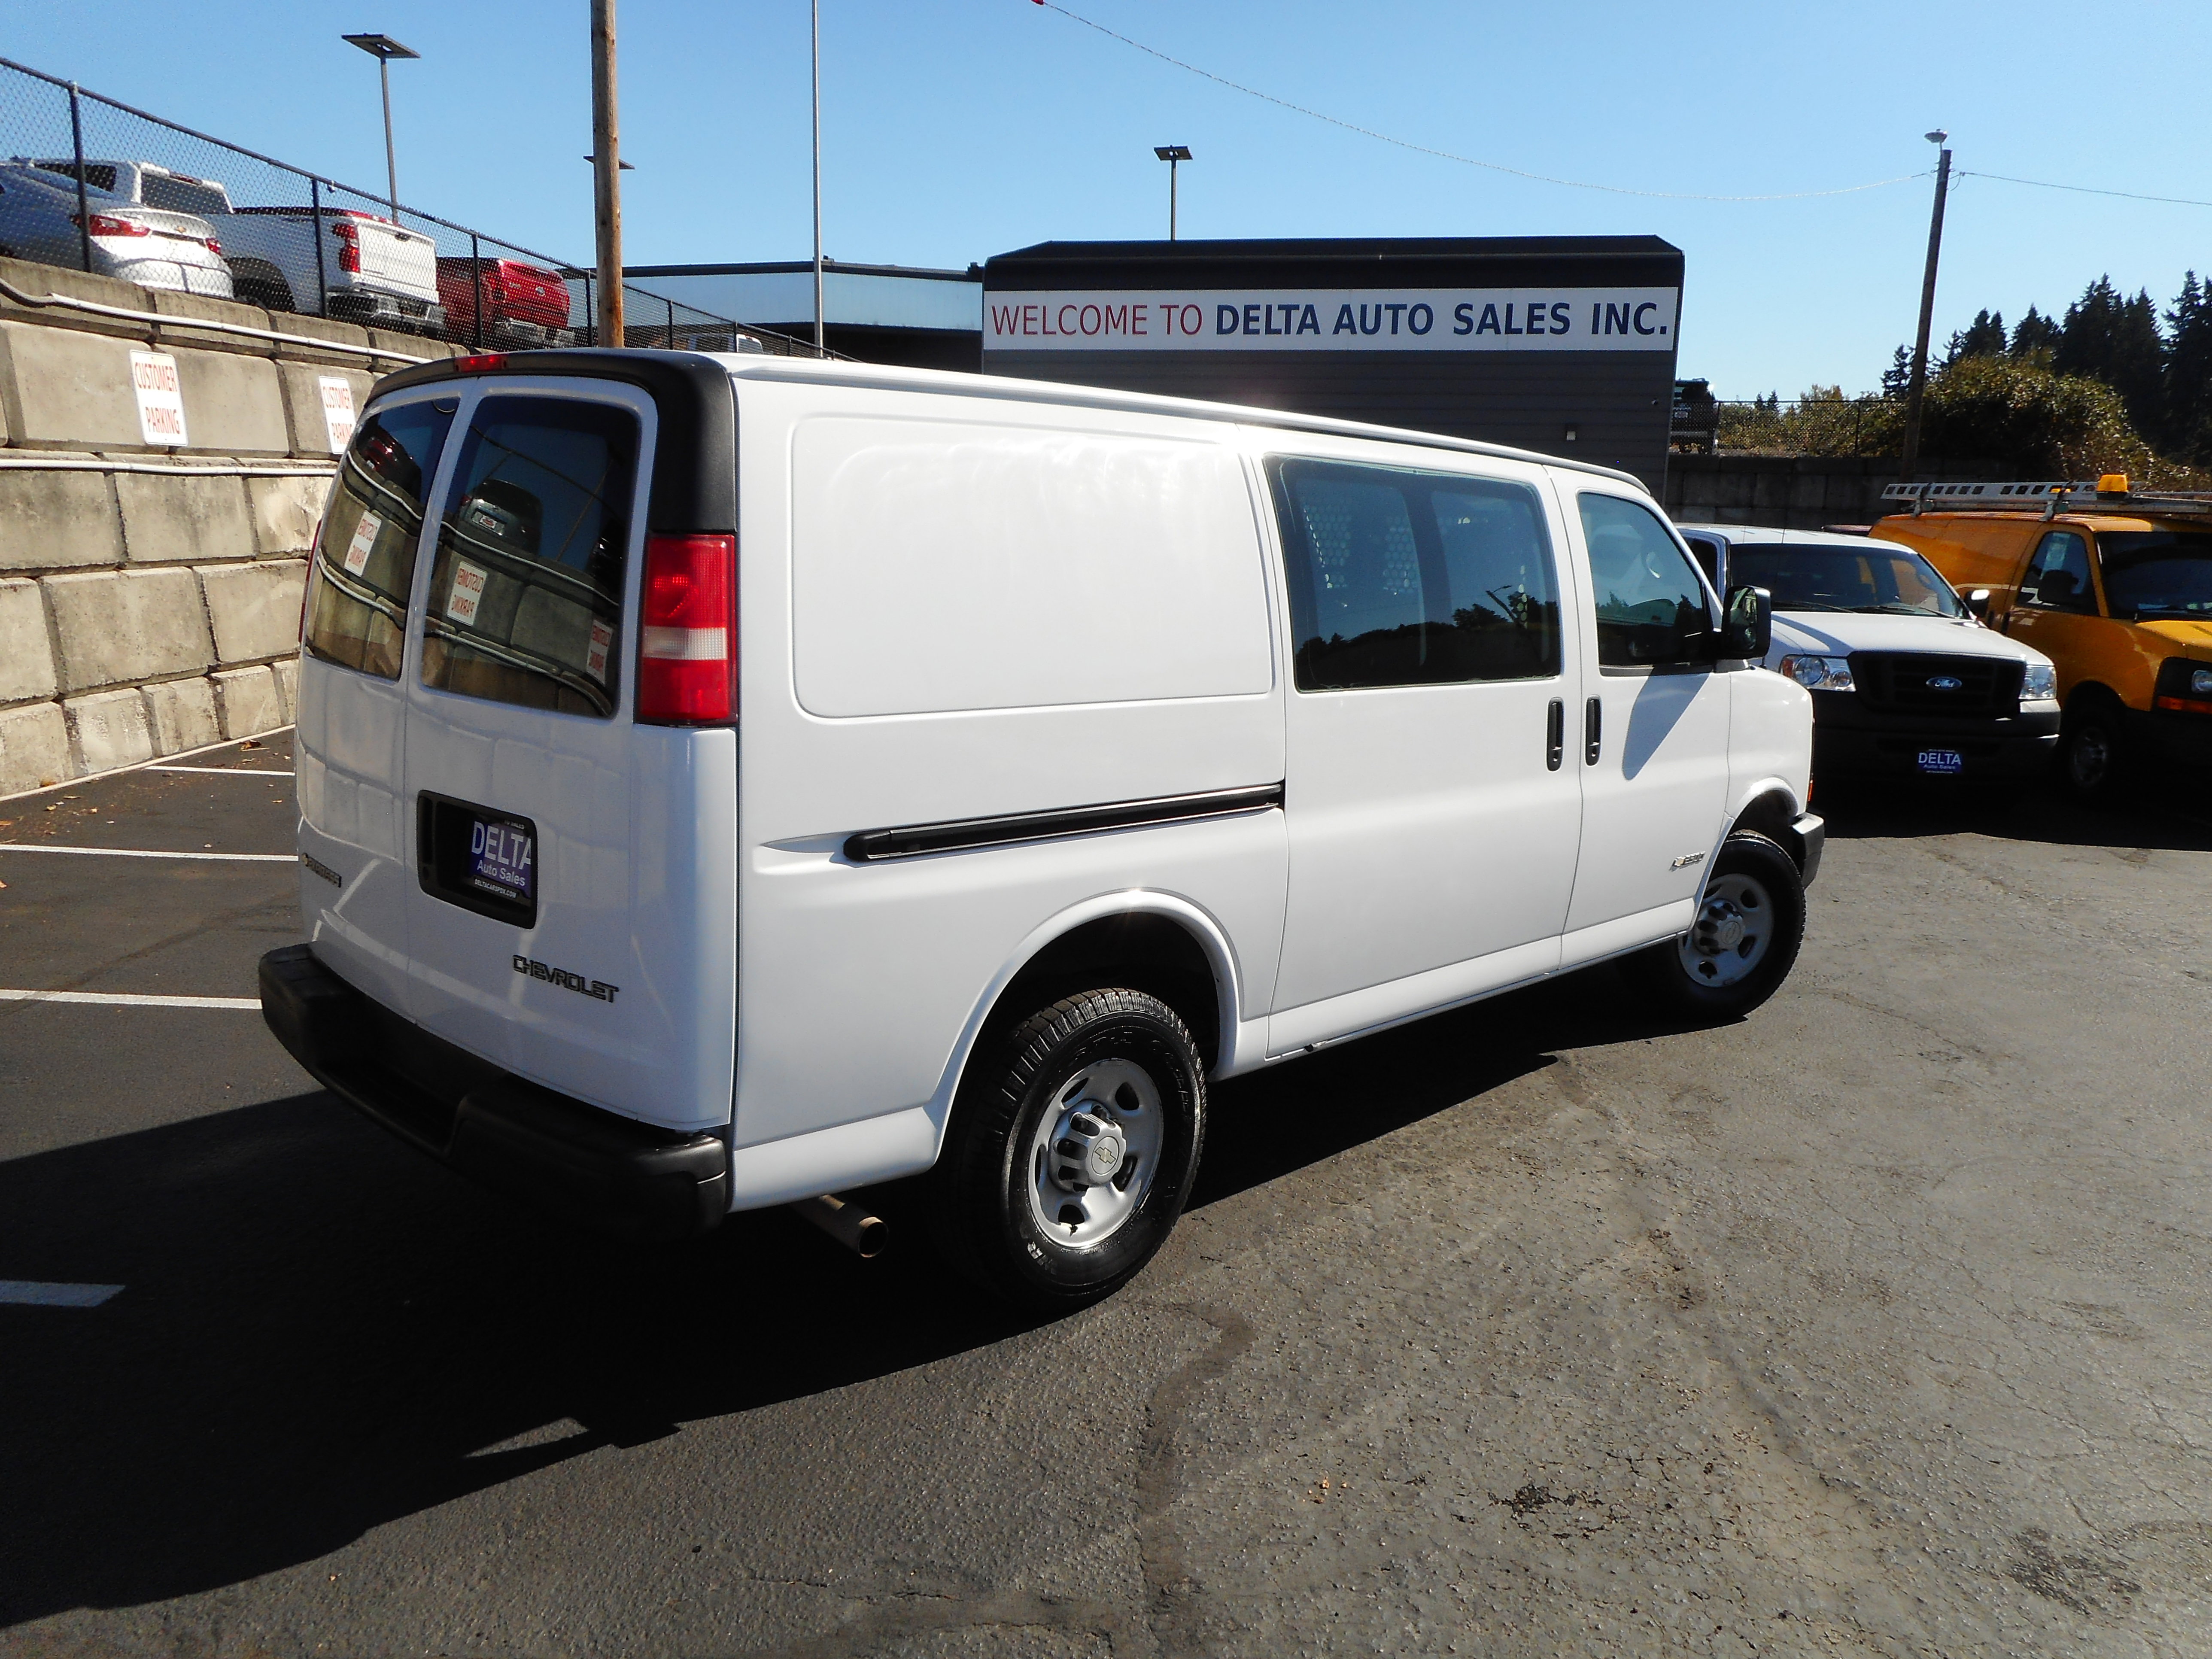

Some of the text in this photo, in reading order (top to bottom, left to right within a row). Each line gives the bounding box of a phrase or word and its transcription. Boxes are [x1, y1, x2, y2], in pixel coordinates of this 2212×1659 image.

[992, 302, 1668, 336] WELCOME TO DELTA AUTO SALES INC.
[135, 362, 178, 392] CUSTOMER
[323, 386, 352, 409] CUSTOMER
[145, 407, 180, 434] PARKING
[1918, 752, 1962, 765] DELTA
[471, 821, 532, 870] DELTA
[477, 860, 526, 887] Auto Sales
[513, 954, 620, 1003] CHEVROLET
